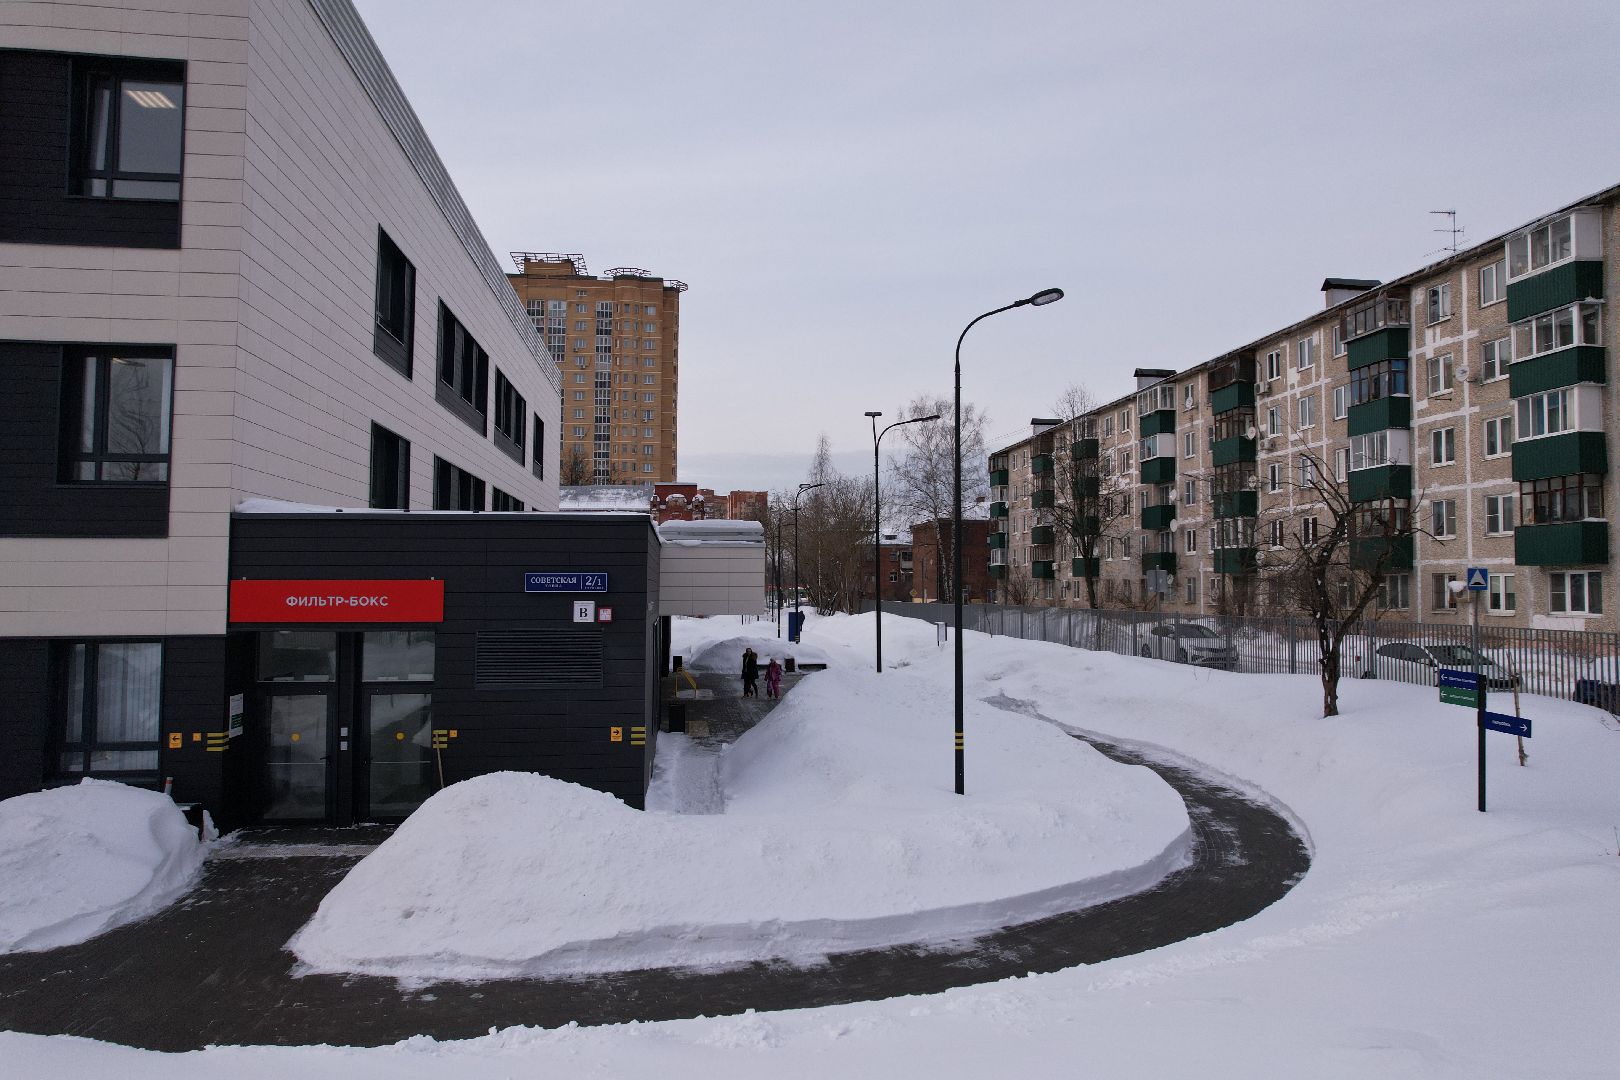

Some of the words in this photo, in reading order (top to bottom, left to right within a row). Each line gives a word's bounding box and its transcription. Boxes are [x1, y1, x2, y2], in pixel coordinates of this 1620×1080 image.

[530, 576, 577, 584] СОВЕТСКАЯ
[585, 575, 602, 586] 2/1
[285, 595, 389, 607] ФИЛЬТР-БОКС
[579, 607, 587, 617] В
